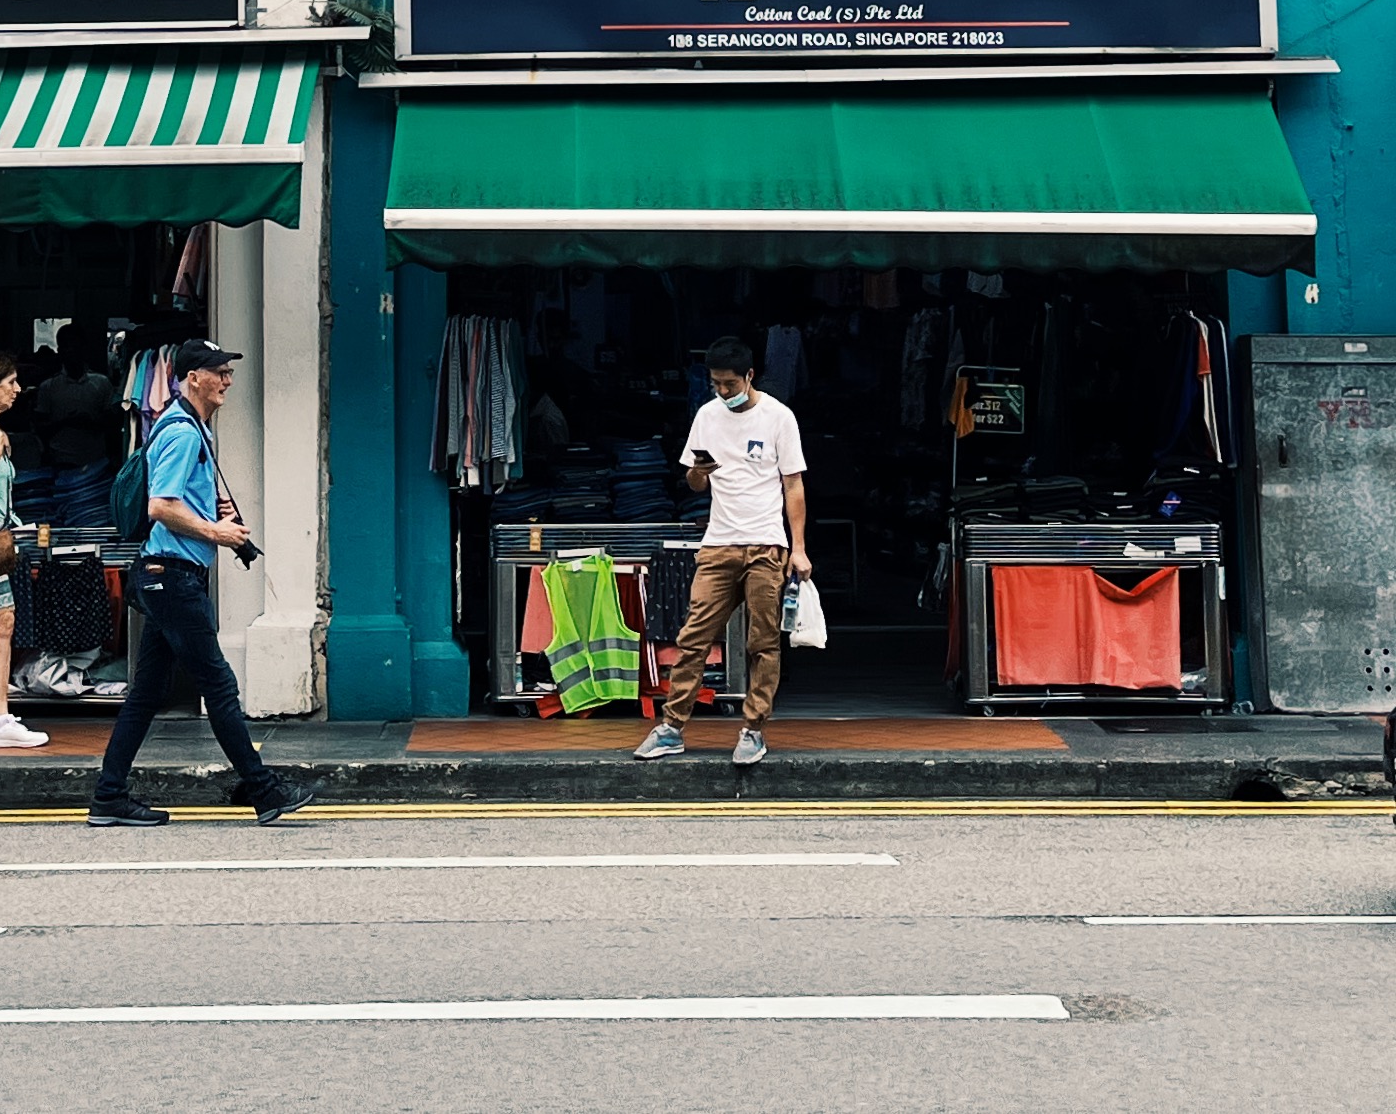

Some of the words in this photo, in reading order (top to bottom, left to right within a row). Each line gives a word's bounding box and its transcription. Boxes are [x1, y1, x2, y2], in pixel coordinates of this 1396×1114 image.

[744, 5, 793, 22] Cotton
[796, 5, 832, 22] Cool
[835, 7, 861, 24] (S)
[864, 4, 892, 21] Pte
[895, 4, 924, 20] Ltd
[697, 33, 798, 48] SERANGOON
[801, 33, 853, 48] ROAD,
[855, 32, 949, 47] SINGAPORE
[951, 31, 1005, 46] 218023
